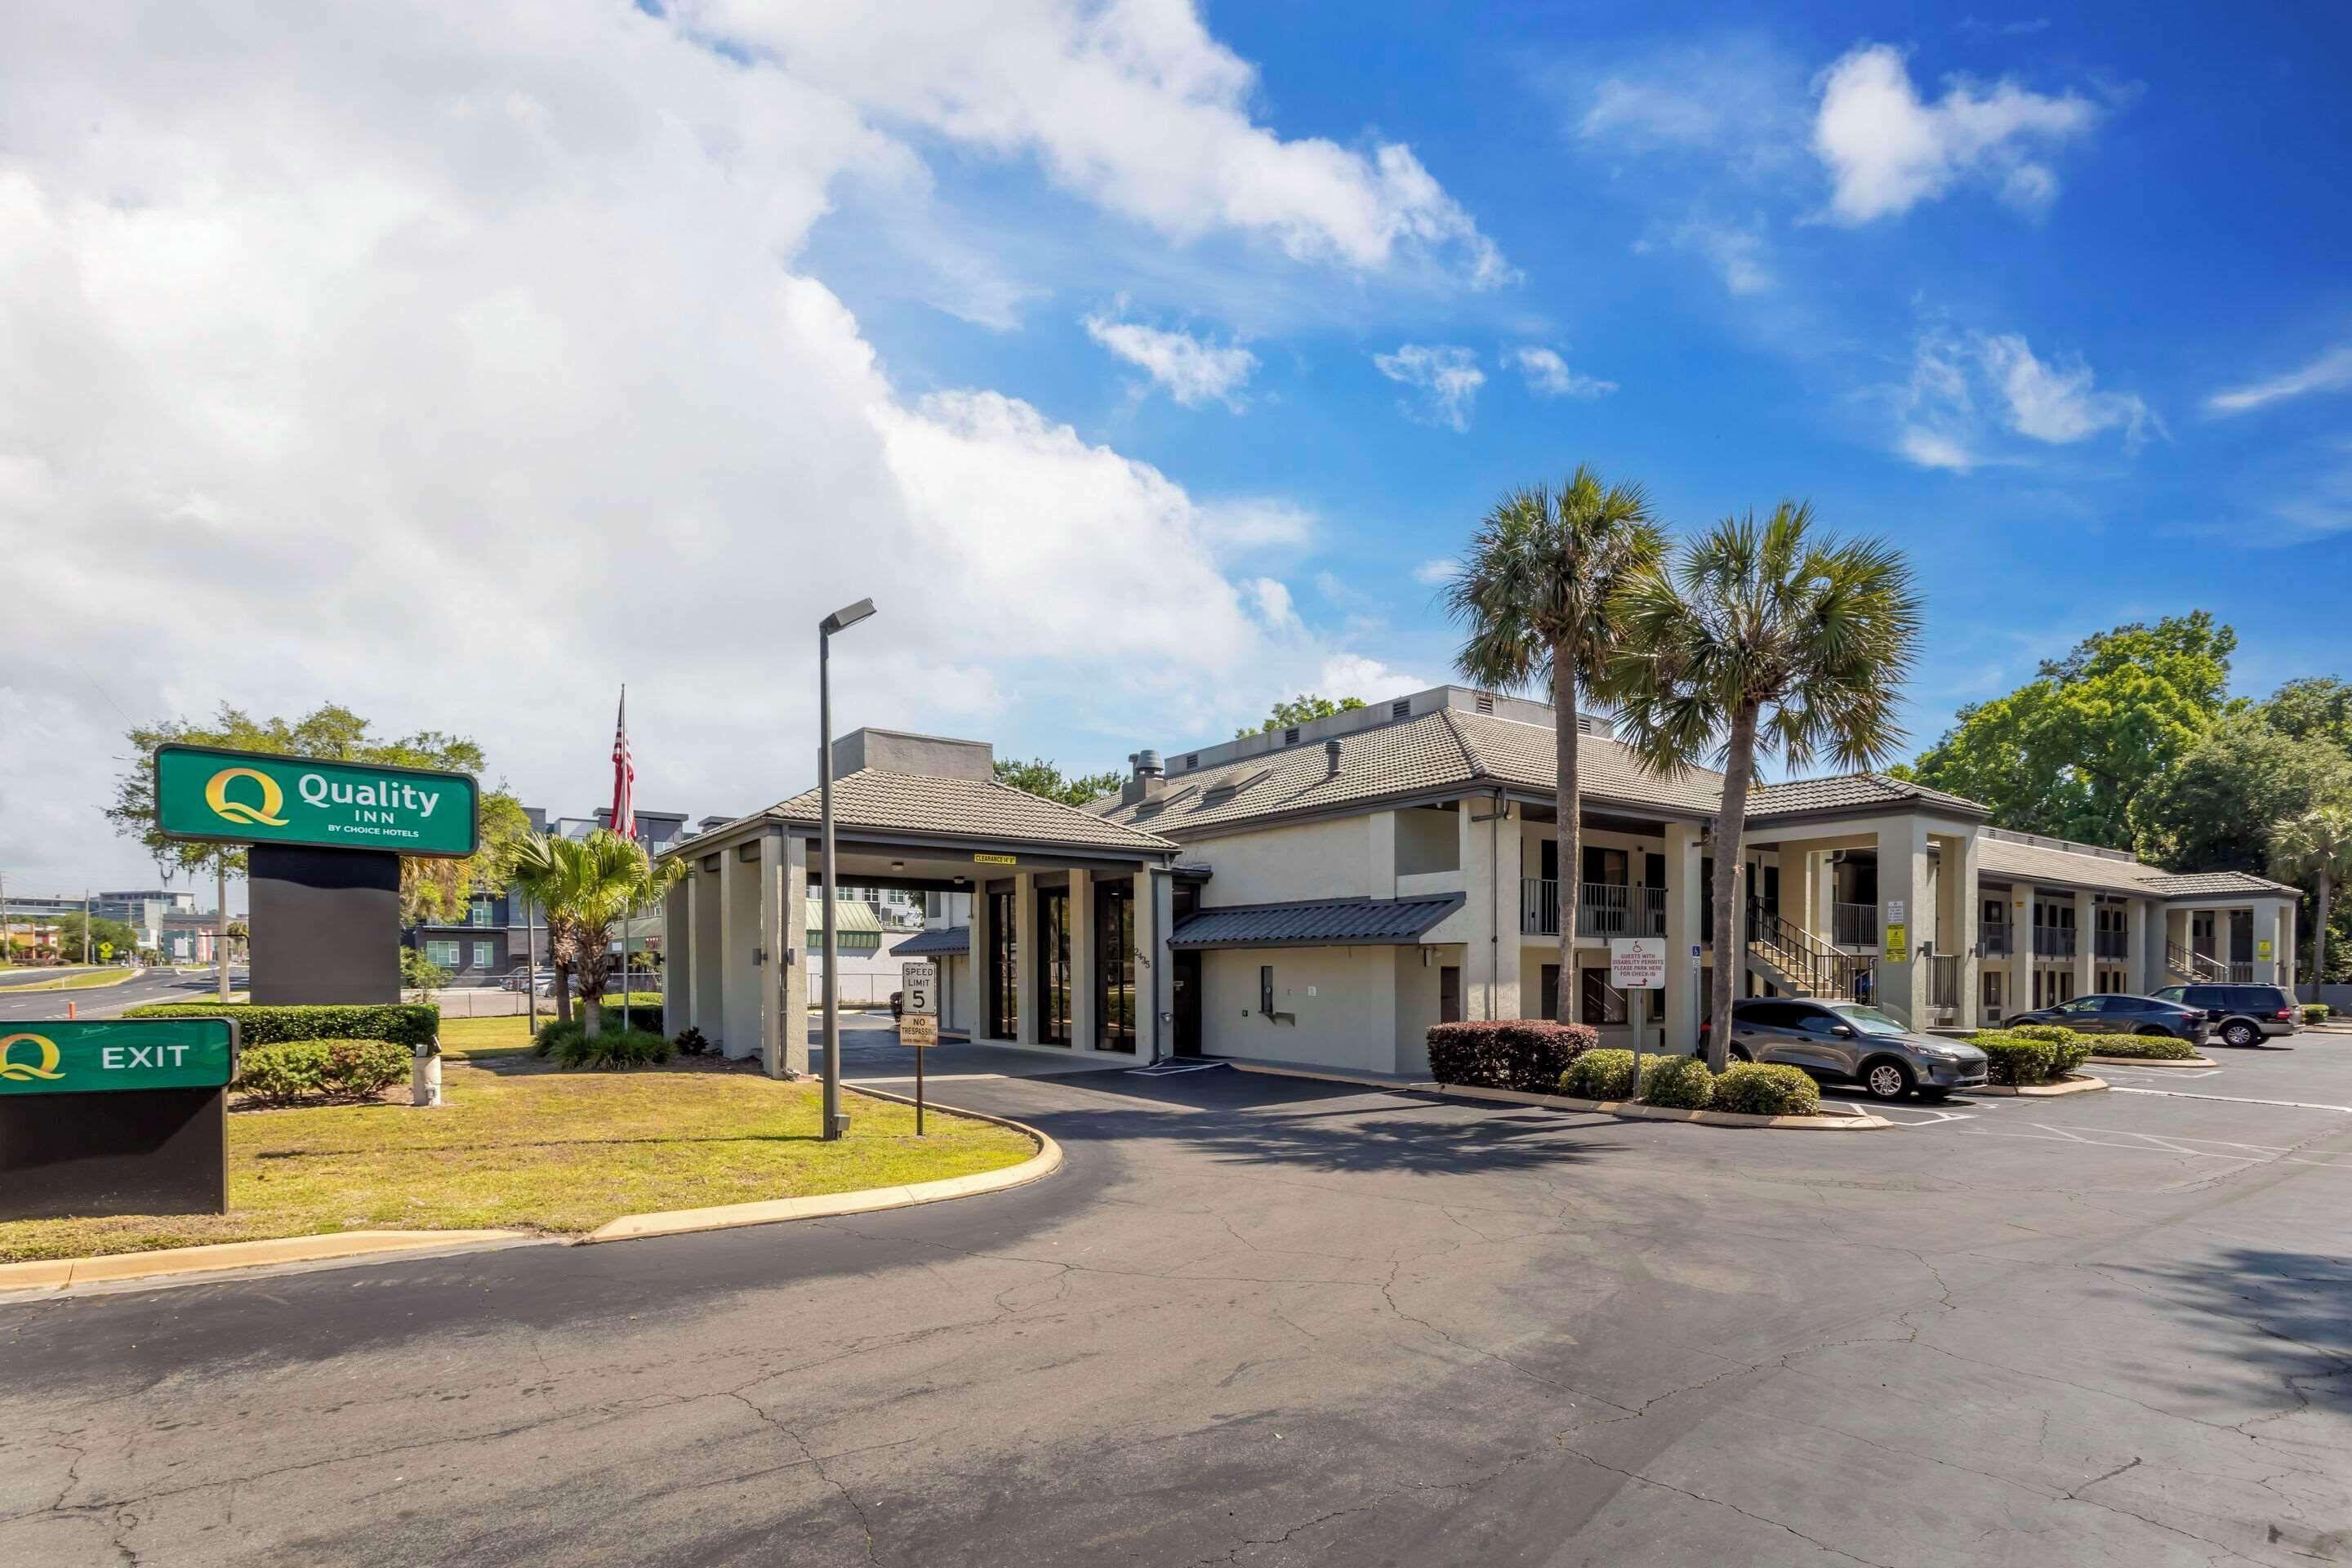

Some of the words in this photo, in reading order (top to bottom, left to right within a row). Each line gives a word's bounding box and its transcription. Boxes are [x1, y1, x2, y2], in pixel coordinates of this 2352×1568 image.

[299, 773, 439, 817] Quality
[354, 809, 394, 824] INN
[327, 824, 341, 832] BY
[344, 826, 381, 835] CHOICE
[382, 828, 419, 838] HOTELS
[905, 968, 933, 976] SPEED
[908, 979, 930, 987] LIMIT
[913, 990, 925, 1009] 5
[913, 1018, 925, 1027] NO
[902, 1027, 937, 1036] TRESPASS
[102, 1045, 190, 1069] EXIT
